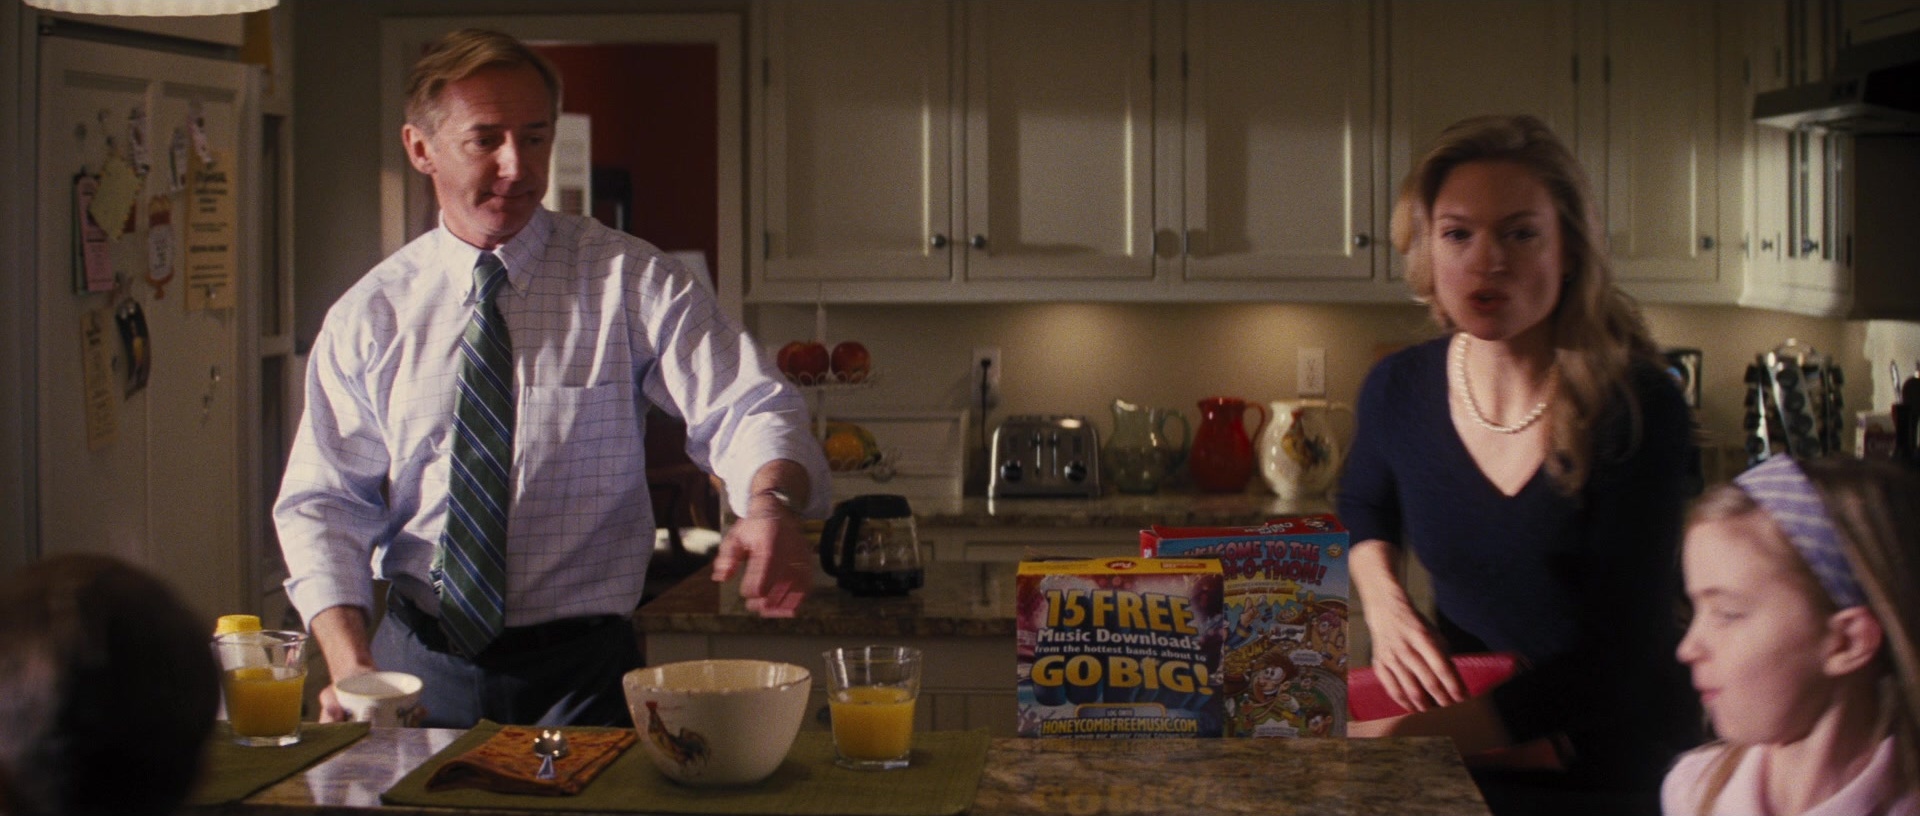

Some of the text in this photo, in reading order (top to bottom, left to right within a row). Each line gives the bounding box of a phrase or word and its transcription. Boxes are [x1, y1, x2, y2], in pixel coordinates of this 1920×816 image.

[1266, 541, 1287, 559] TO
[1290, 542, 1320, 562] THE
[1047, 589, 1198, 635] 15 FREE
[1038, 628, 1201, 650] Music Downloads
[1034, 644, 1207, 662] from the hottest bands about to
[1031, 655, 1214, 695] GO BIG!
[1042, 718, 1198, 734] HONEYCOMBFREEMUSIC.COM
